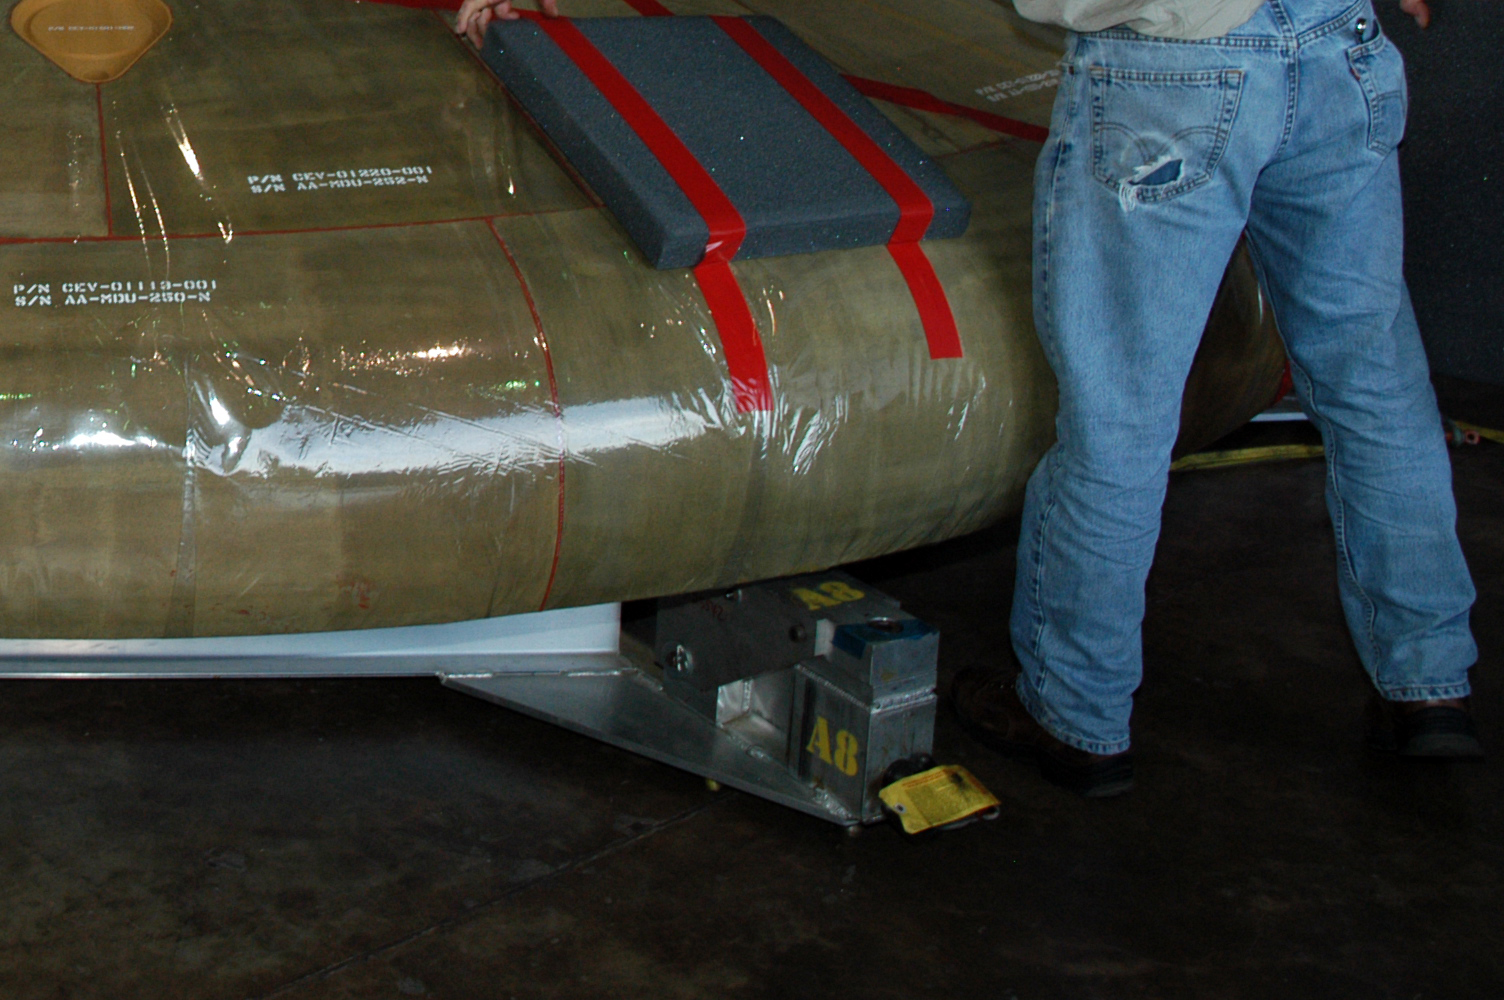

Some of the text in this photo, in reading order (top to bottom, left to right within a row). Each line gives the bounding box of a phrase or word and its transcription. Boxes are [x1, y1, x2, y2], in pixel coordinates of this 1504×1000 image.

[247, 165, 434, 185] P/N CEV-01220-001
[249, 174, 429, 194] S/N AA-MDU-252-N
[12, 283, 51, 295] P/N
[14, 291, 212, 307] S/N AA-MDU-250-N
[790, 580, 866, 612] A8
[805, 714, 860, 778] A8
